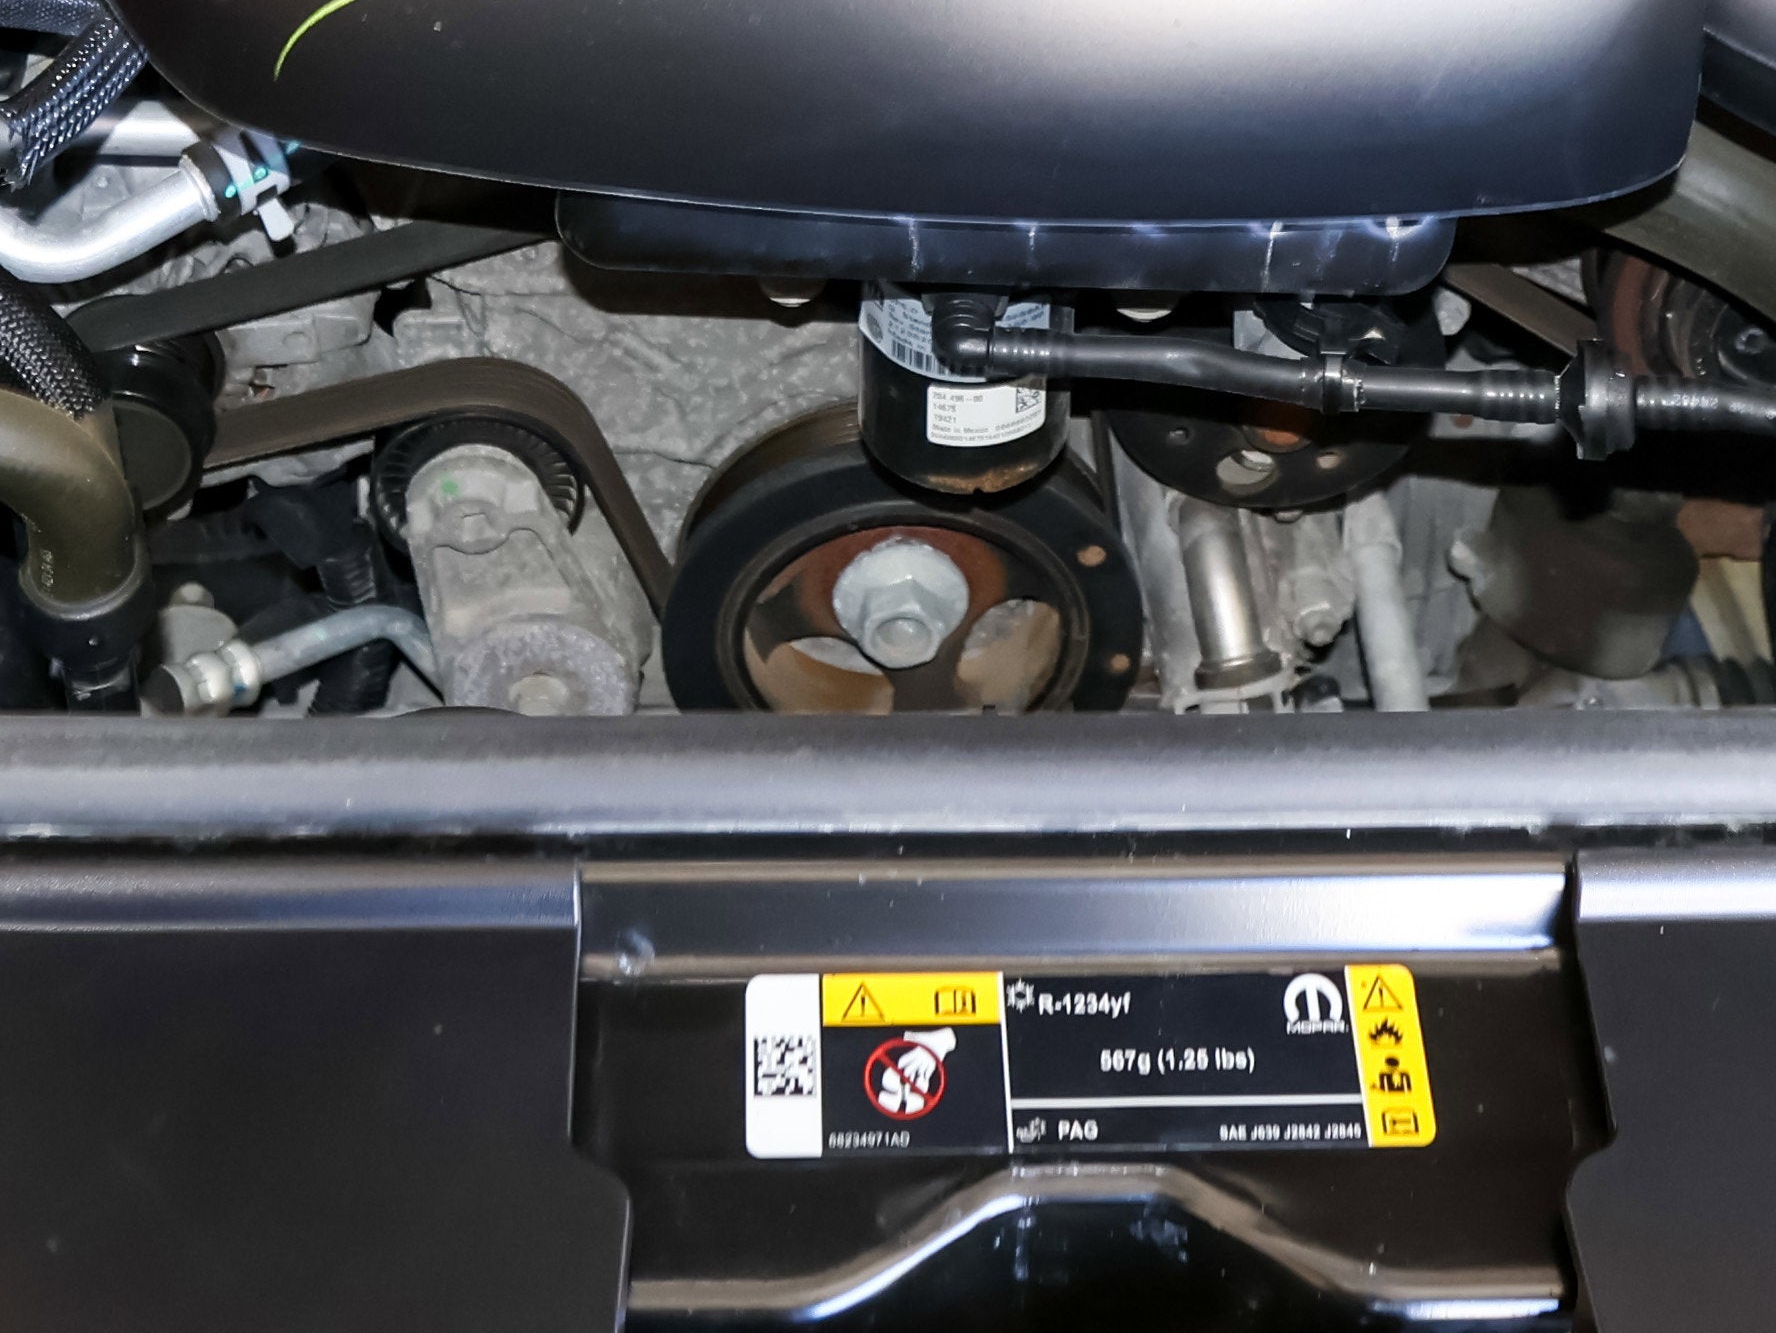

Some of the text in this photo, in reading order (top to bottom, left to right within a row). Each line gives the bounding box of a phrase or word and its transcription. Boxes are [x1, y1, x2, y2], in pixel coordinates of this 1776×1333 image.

[1039, 991, 1131, 1019] R-1234yf
[1214, 1046, 1256, 1074] lbs)
[1058, 1119, 1099, 1141] PAG
